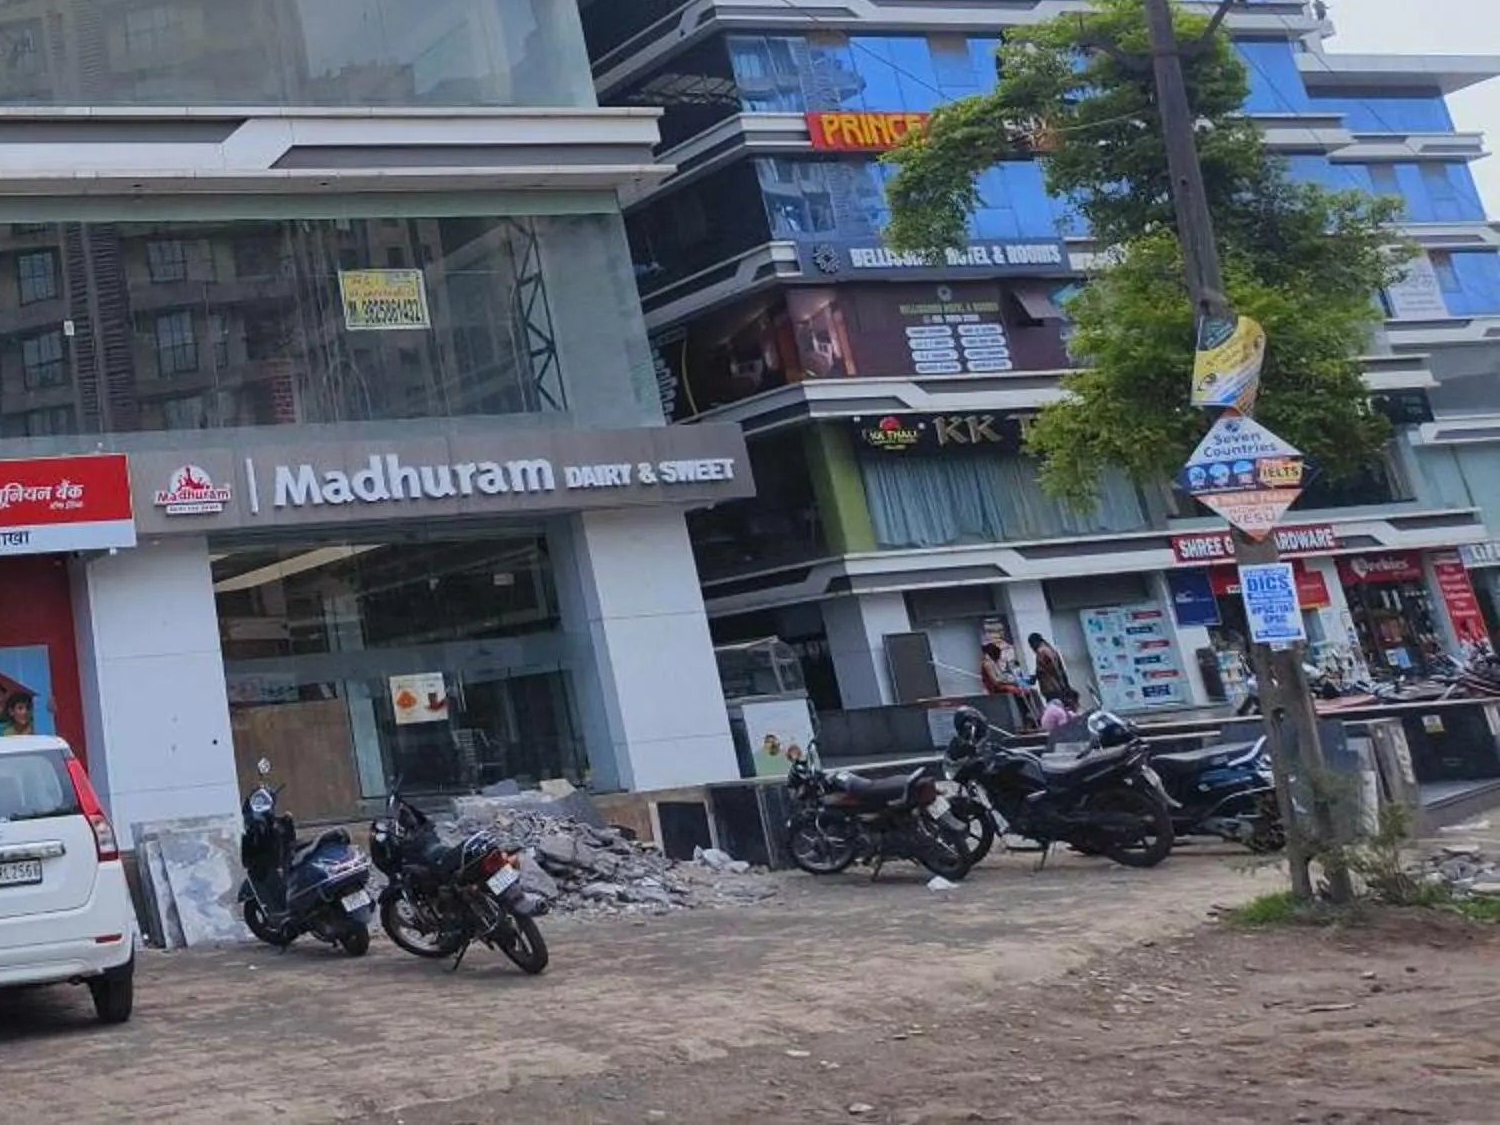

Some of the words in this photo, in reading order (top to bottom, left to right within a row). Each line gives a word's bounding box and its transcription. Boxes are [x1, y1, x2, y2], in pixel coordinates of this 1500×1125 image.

[1005, 244, 1062, 264] ROOMS
[932, 414, 1002, 446] KK
[1213, 433, 1261, 446] Seven
[1203, 442, 1277, 458] Countries
[273, 453, 555, 507] Madhuram
[565, 464, 632, 489] DAIRY
[637, 462, 659, 485] &
[660, 458, 736, 484] SWEET
[1179, 537, 1224, 559] SHREE
[1246, 574, 1290, 592] DICS
